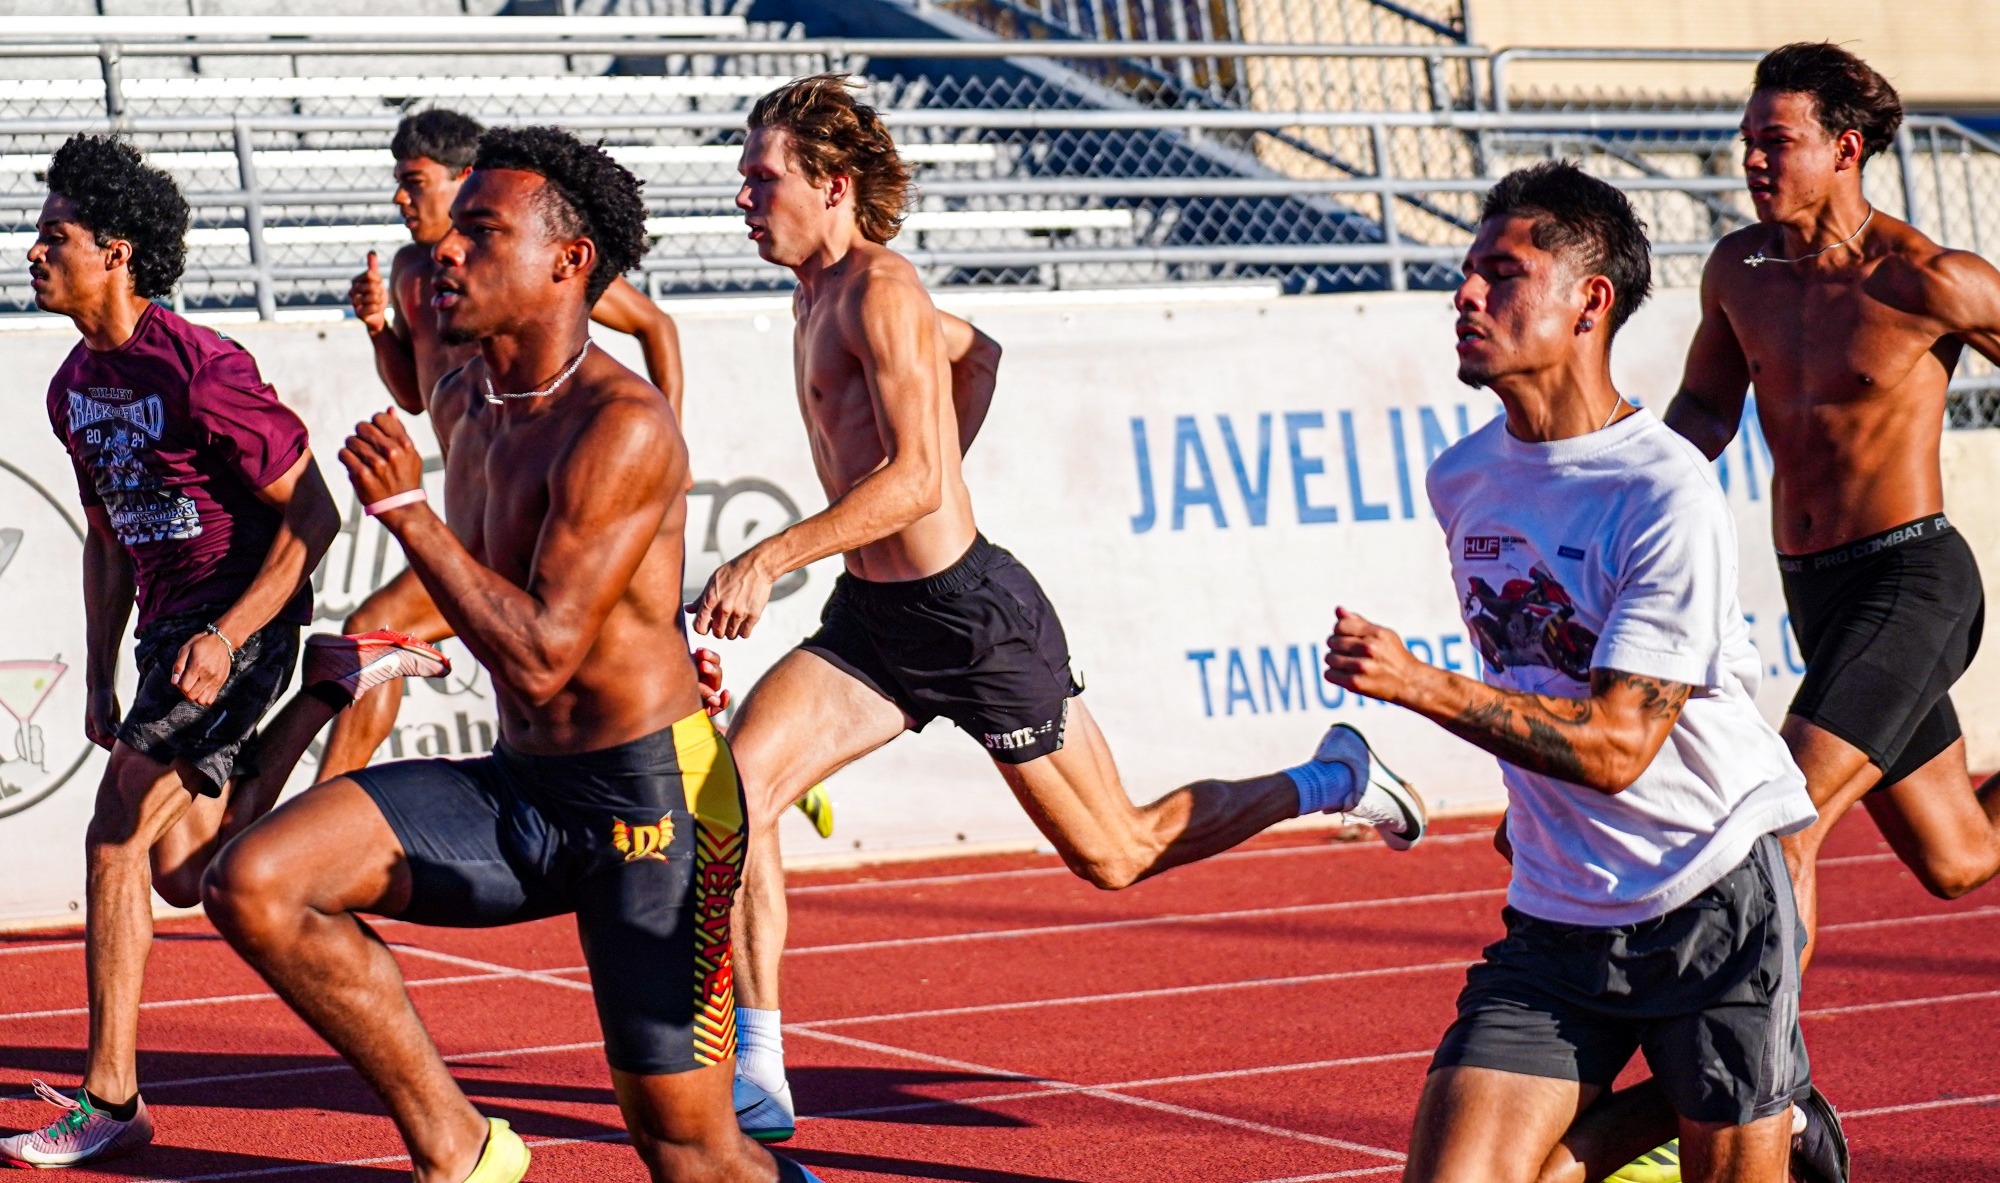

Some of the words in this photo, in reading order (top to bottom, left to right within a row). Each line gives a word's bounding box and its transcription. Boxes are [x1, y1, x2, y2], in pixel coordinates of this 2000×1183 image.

[67, 388, 112, 434] TRACK
[120, 394, 164, 440] FIELD
[86, 428, 101, 444] 20
[130, 432, 145, 448] 24
[1465, 538, 1499, 553] HUF
[1852, 522, 1924, 558] COMBAT
[984, 727, 1036, 750] STATE
